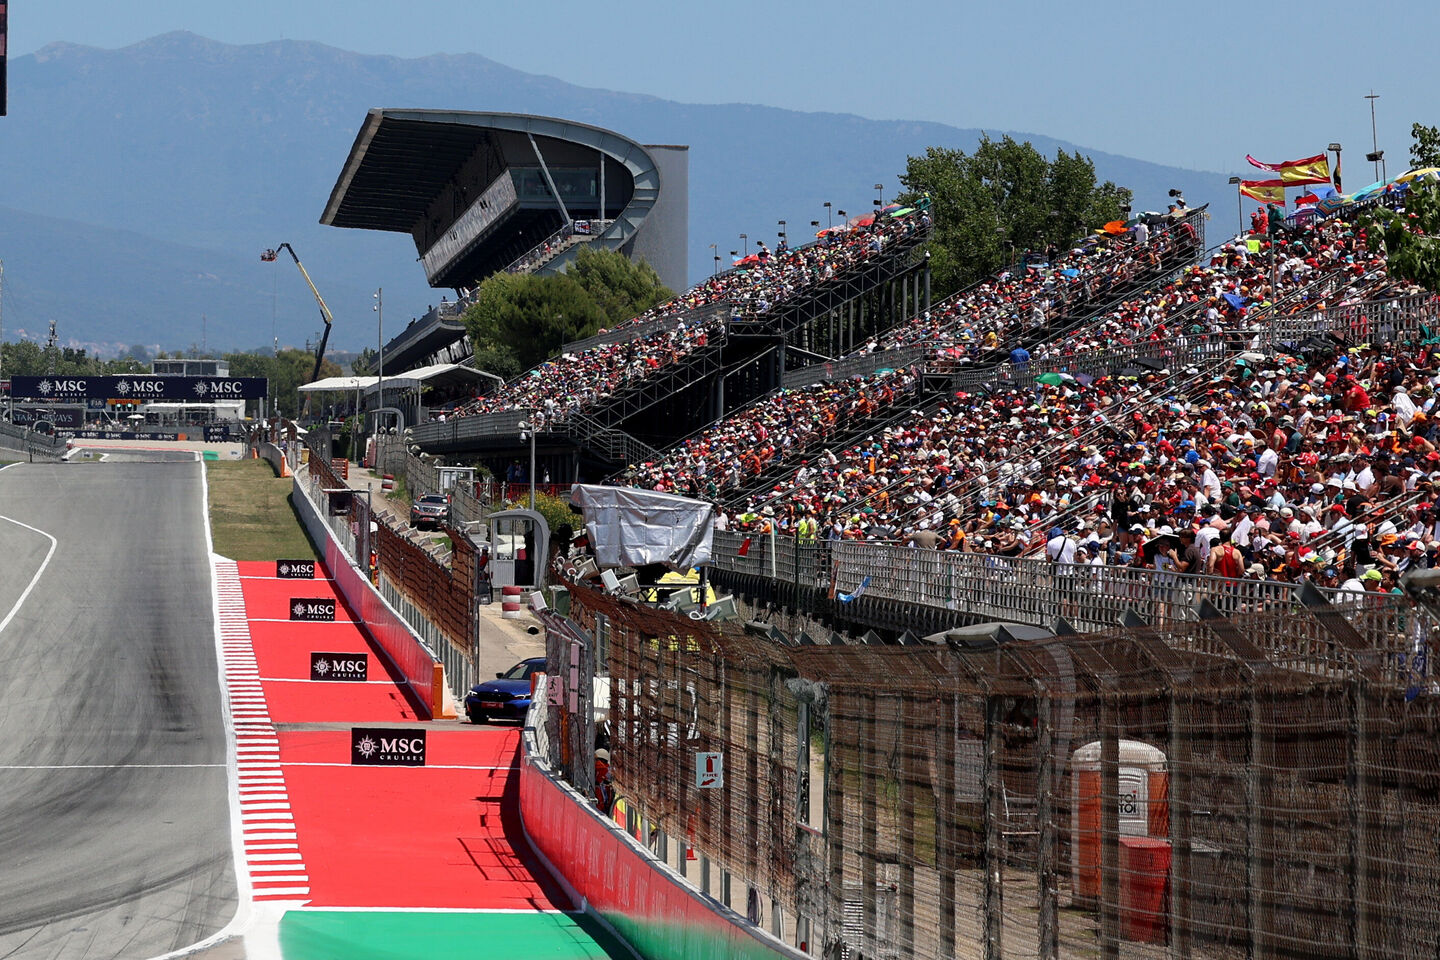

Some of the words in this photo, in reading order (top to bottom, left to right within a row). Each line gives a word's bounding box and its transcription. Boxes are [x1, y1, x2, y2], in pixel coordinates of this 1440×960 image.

[55, 380, 87, 392] MSC
[133, 381, 164, 392] MSC
[210, 381, 242, 393] MSC
[291, 564, 314, 573] MSC
[307, 604, 334, 614] MSC
[333, 660, 366, 672] MSC
[380, 738, 424, 753] MSC
